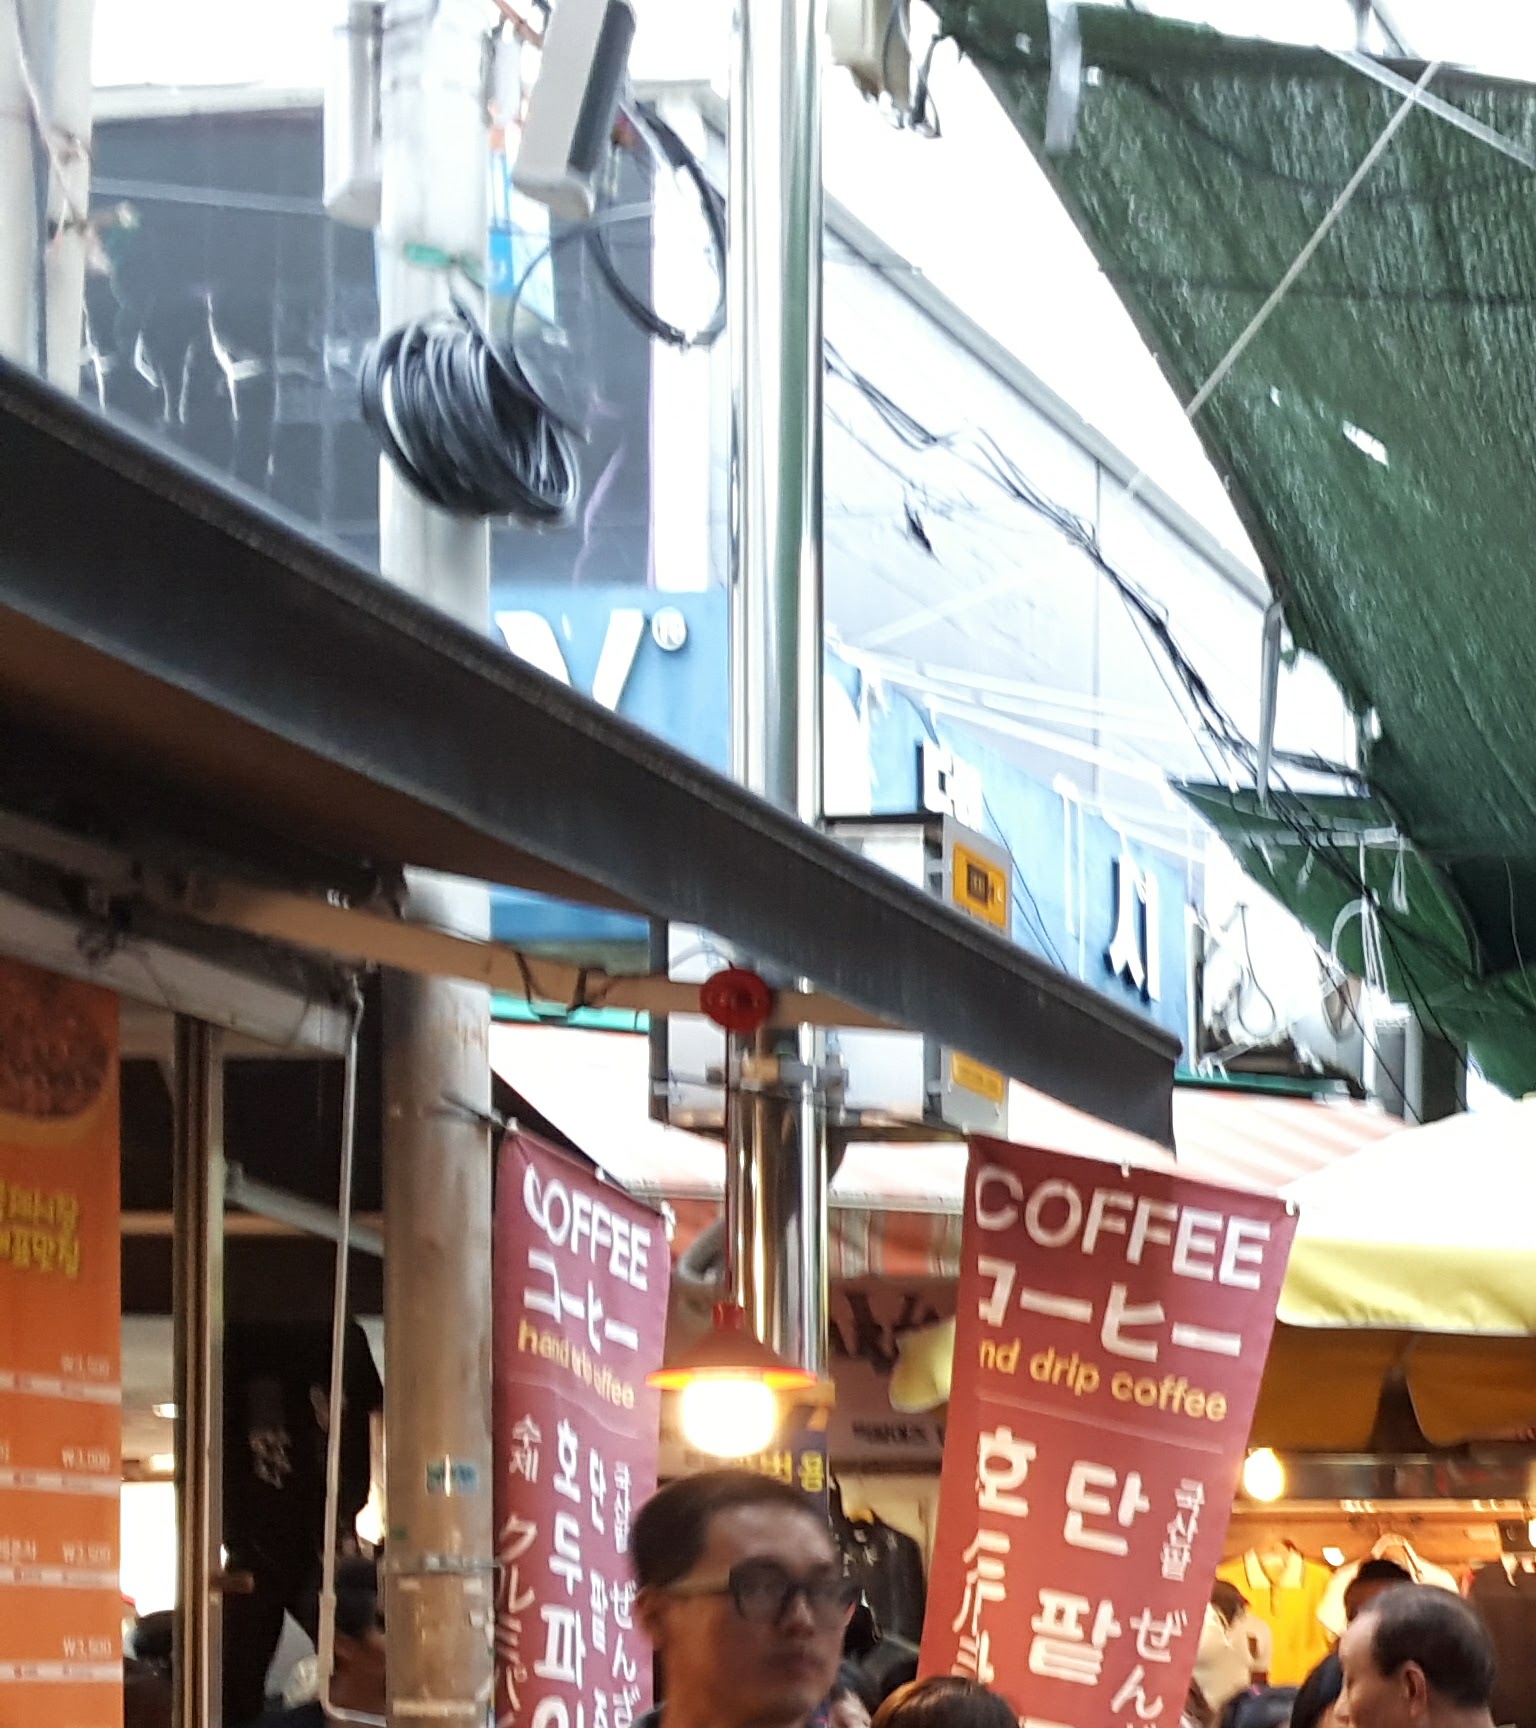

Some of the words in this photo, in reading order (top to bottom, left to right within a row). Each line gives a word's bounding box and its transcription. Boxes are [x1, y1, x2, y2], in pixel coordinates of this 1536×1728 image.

[523, 1163, 651, 1292] COFFEE
[974, 1162, 1272, 1291] COFFEE
[1029, 1347, 1101, 1396] drip
[1110, 1371, 1228, 1424] coffee
